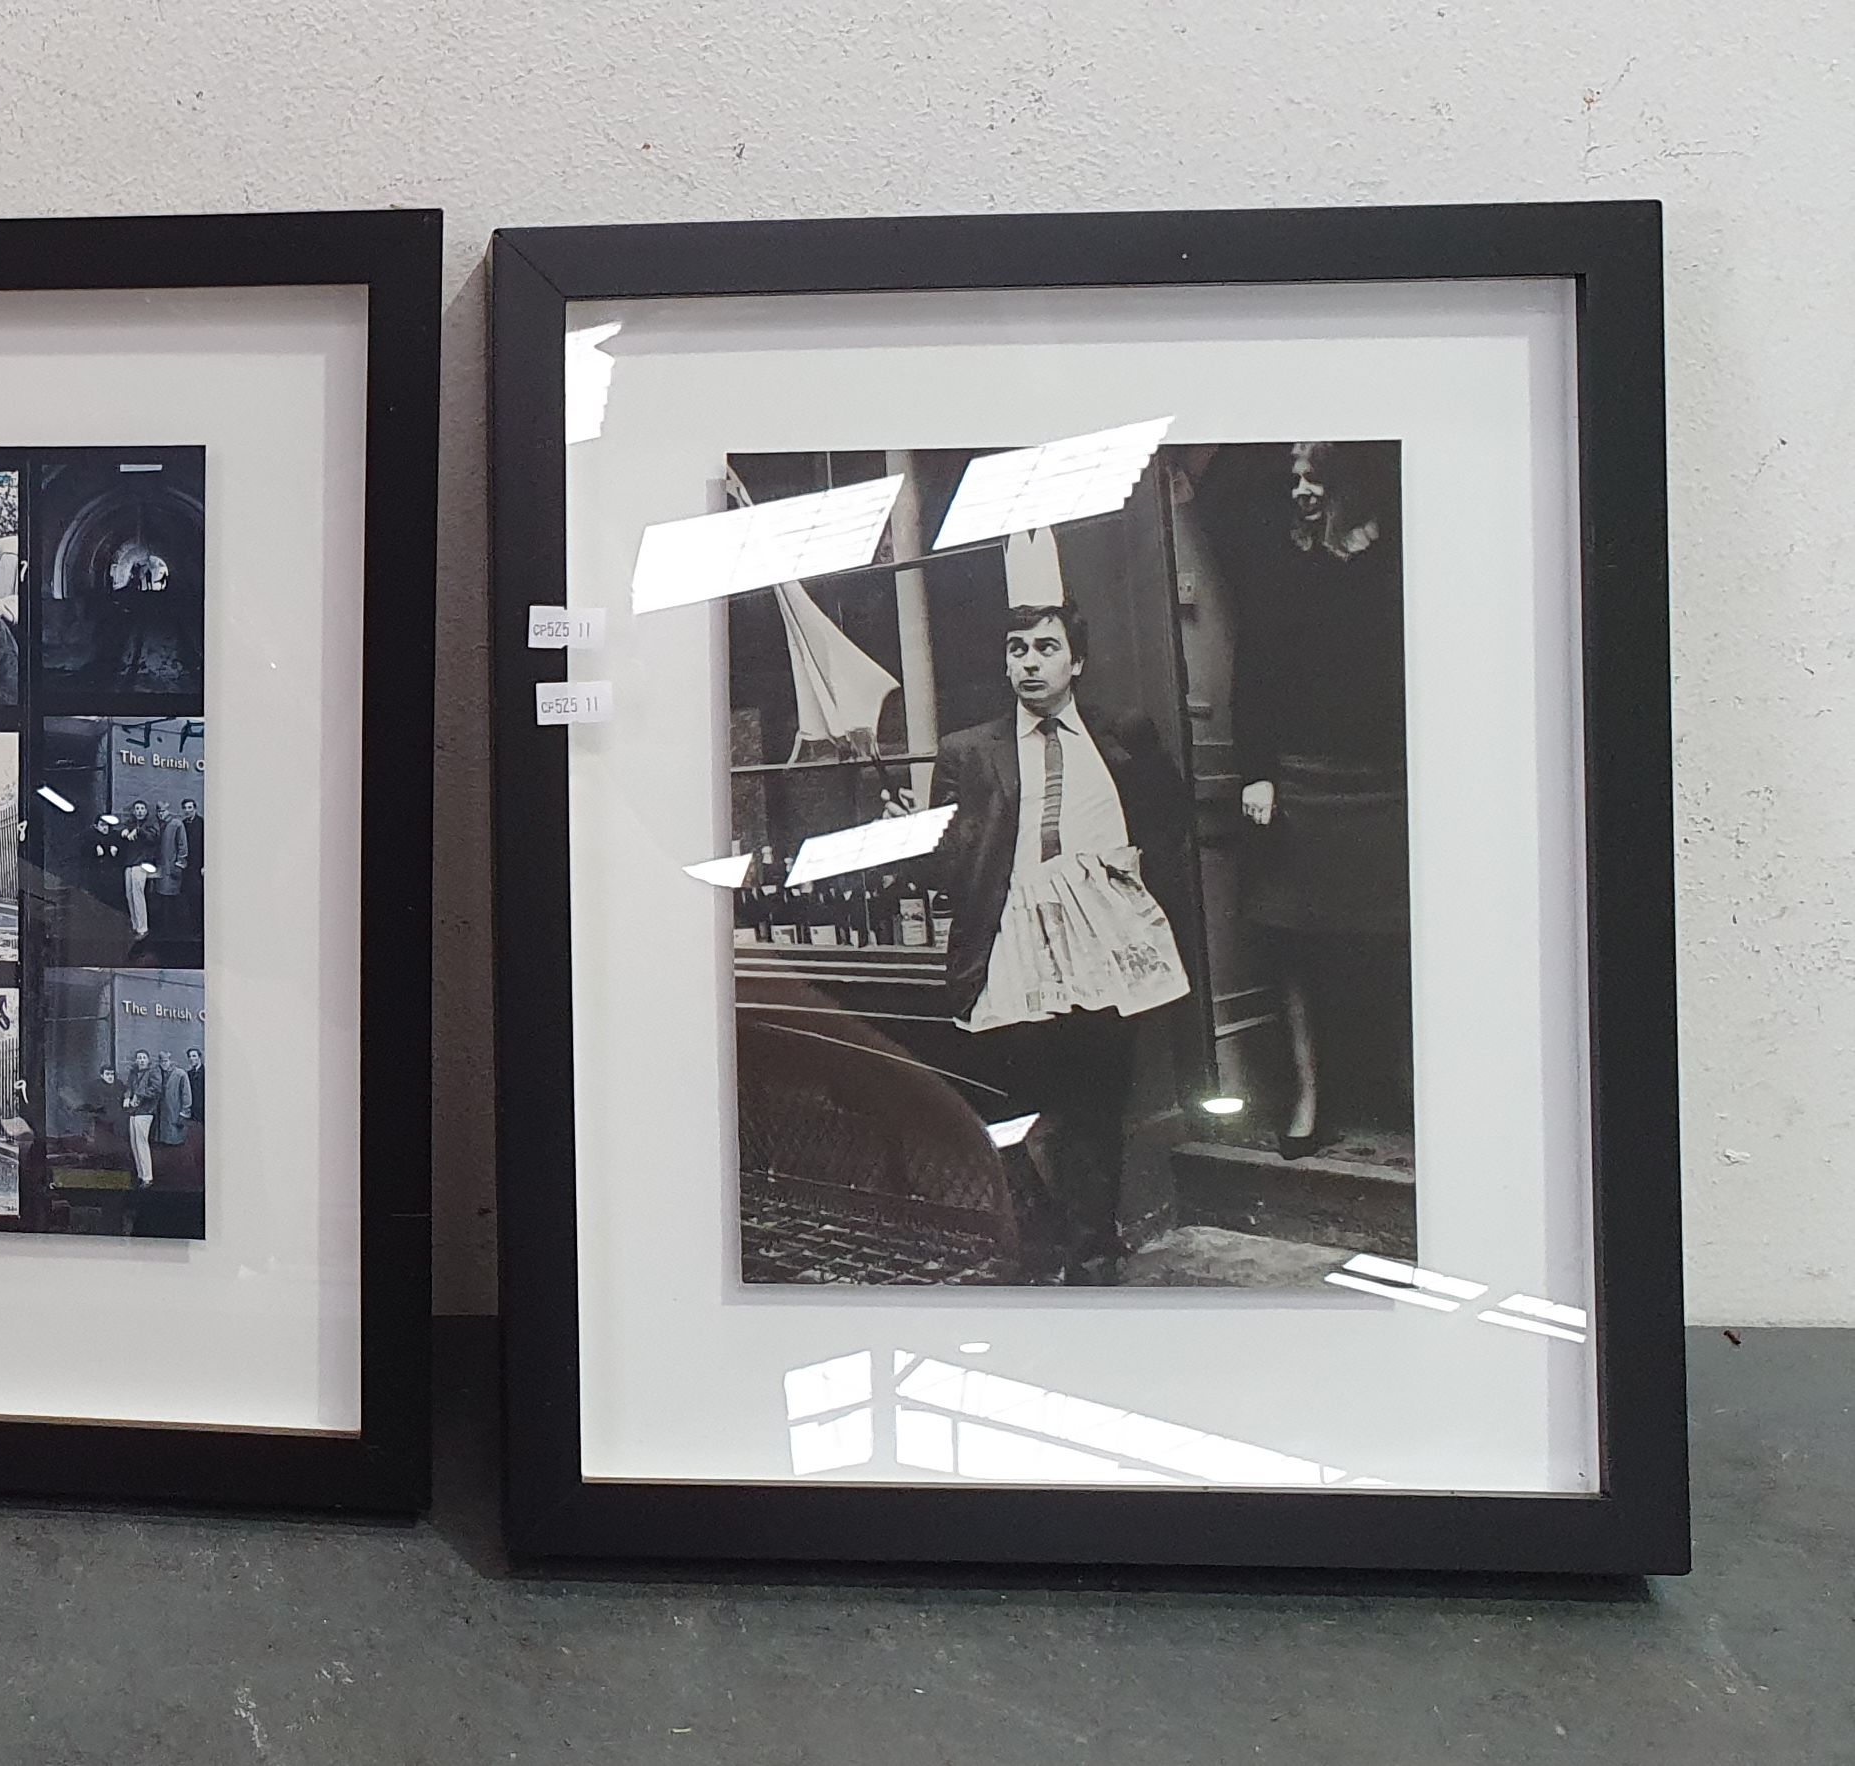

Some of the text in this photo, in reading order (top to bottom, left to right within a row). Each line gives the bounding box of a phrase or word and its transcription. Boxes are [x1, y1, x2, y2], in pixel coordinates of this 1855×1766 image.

[119, 749, 146, 765] The
[152, 752, 190, 770] British
[122, 1000, 148, 1016] The
[155, 1003, 192, 1021] British
